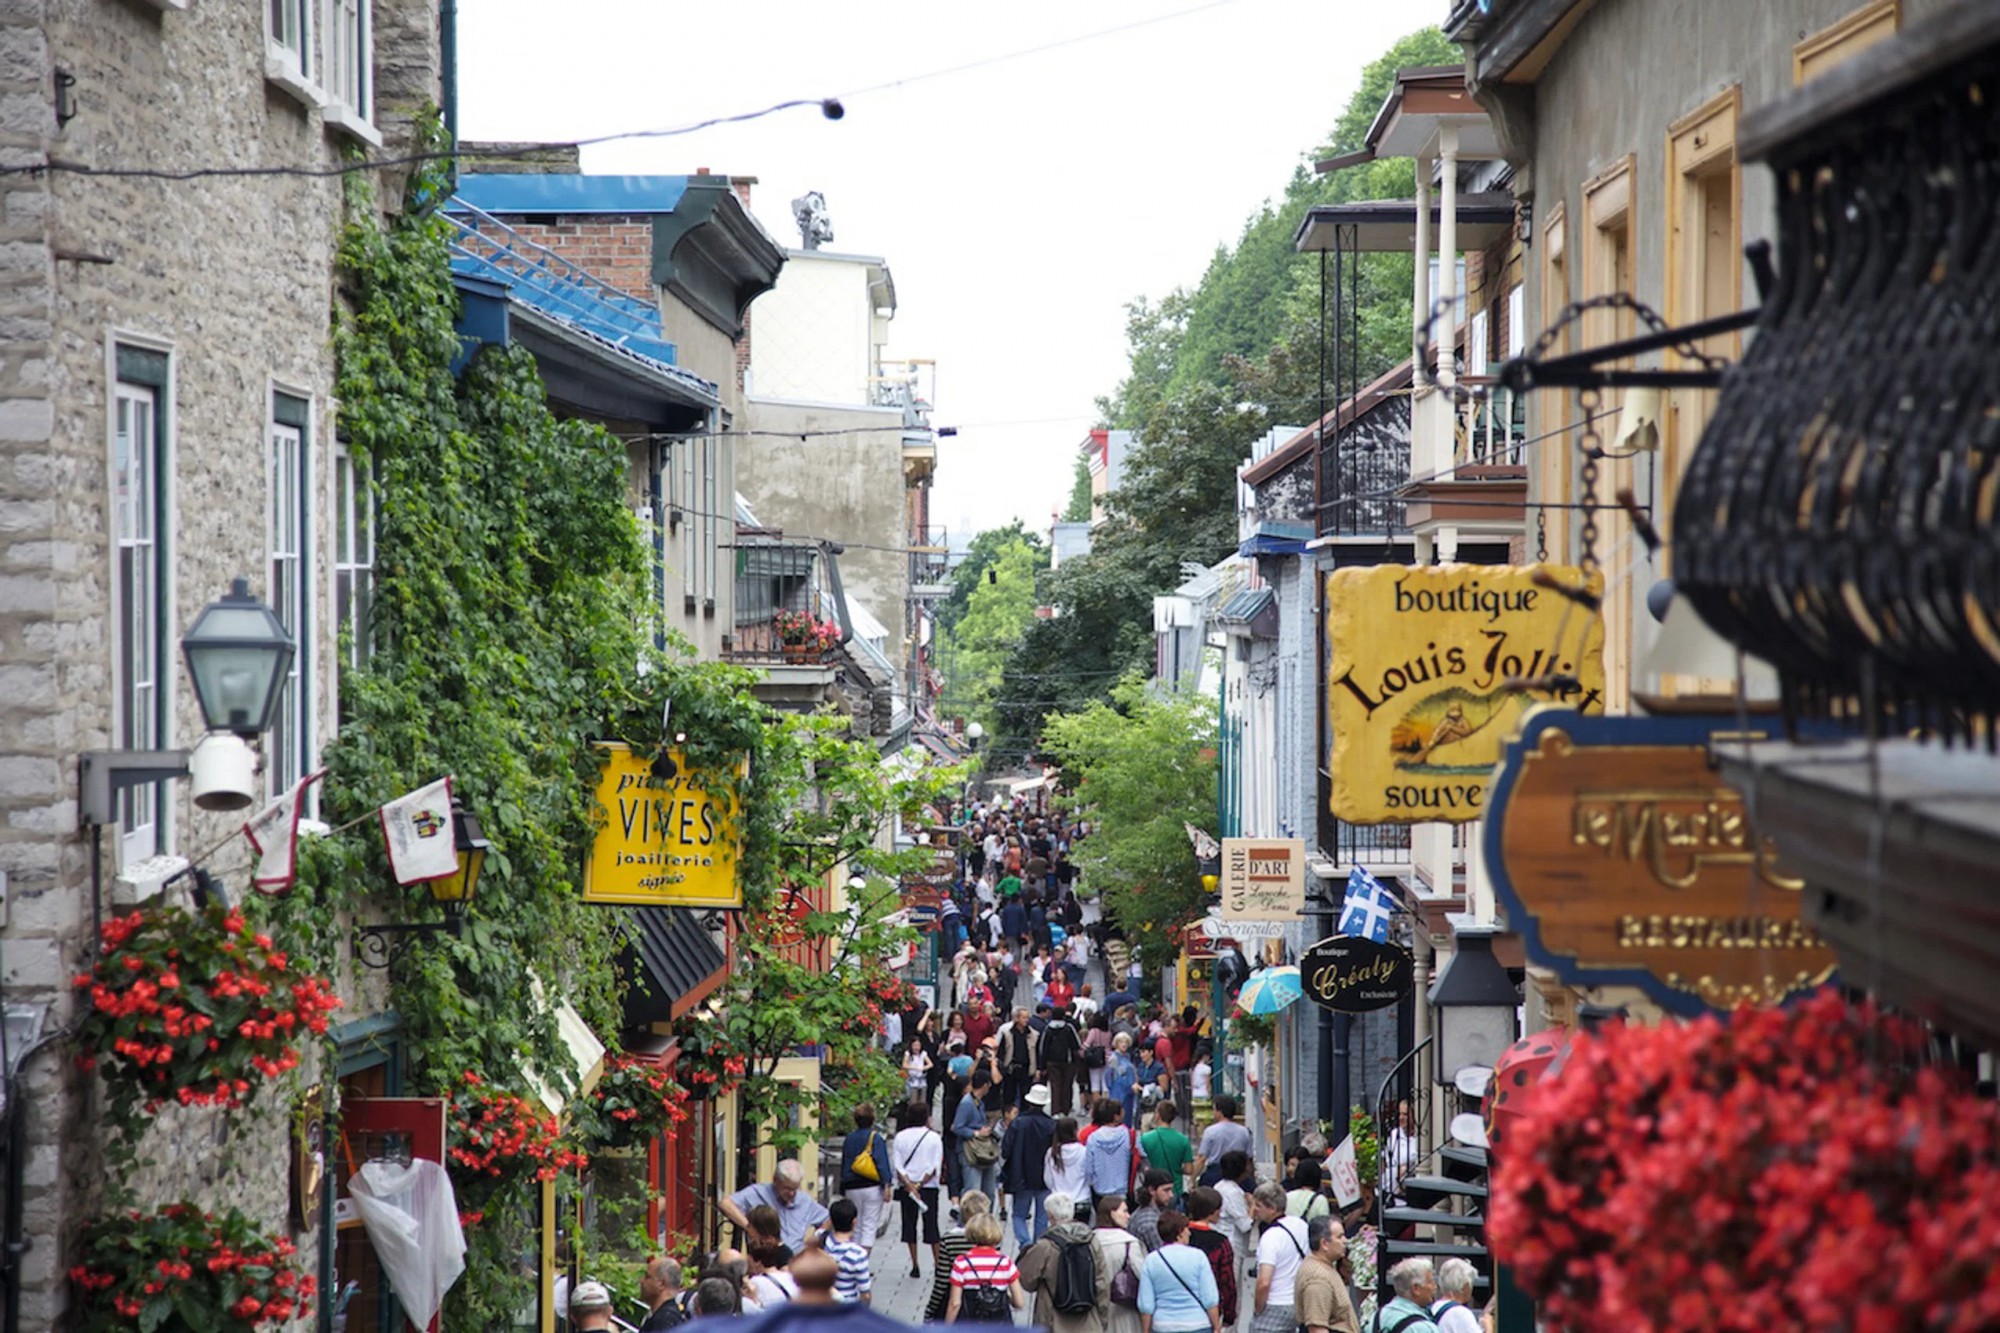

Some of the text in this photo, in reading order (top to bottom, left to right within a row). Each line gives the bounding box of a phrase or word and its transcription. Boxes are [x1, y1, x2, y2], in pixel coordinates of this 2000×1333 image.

[1393, 578, 1539, 623] boutique
[1333, 642, 1466, 721] Louis
[1384, 784, 1489, 808] souve
[618, 798, 715, 847] VIVES
[616, 851, 713, 867] joaillerie
[1249, 860, 1288, 875] D'ART
[1231, 847, 1246, 912] GALERIE
[1616, 913, 1828, 948] RESTAURA
[1316, 947, 1349, 958] Boutique
